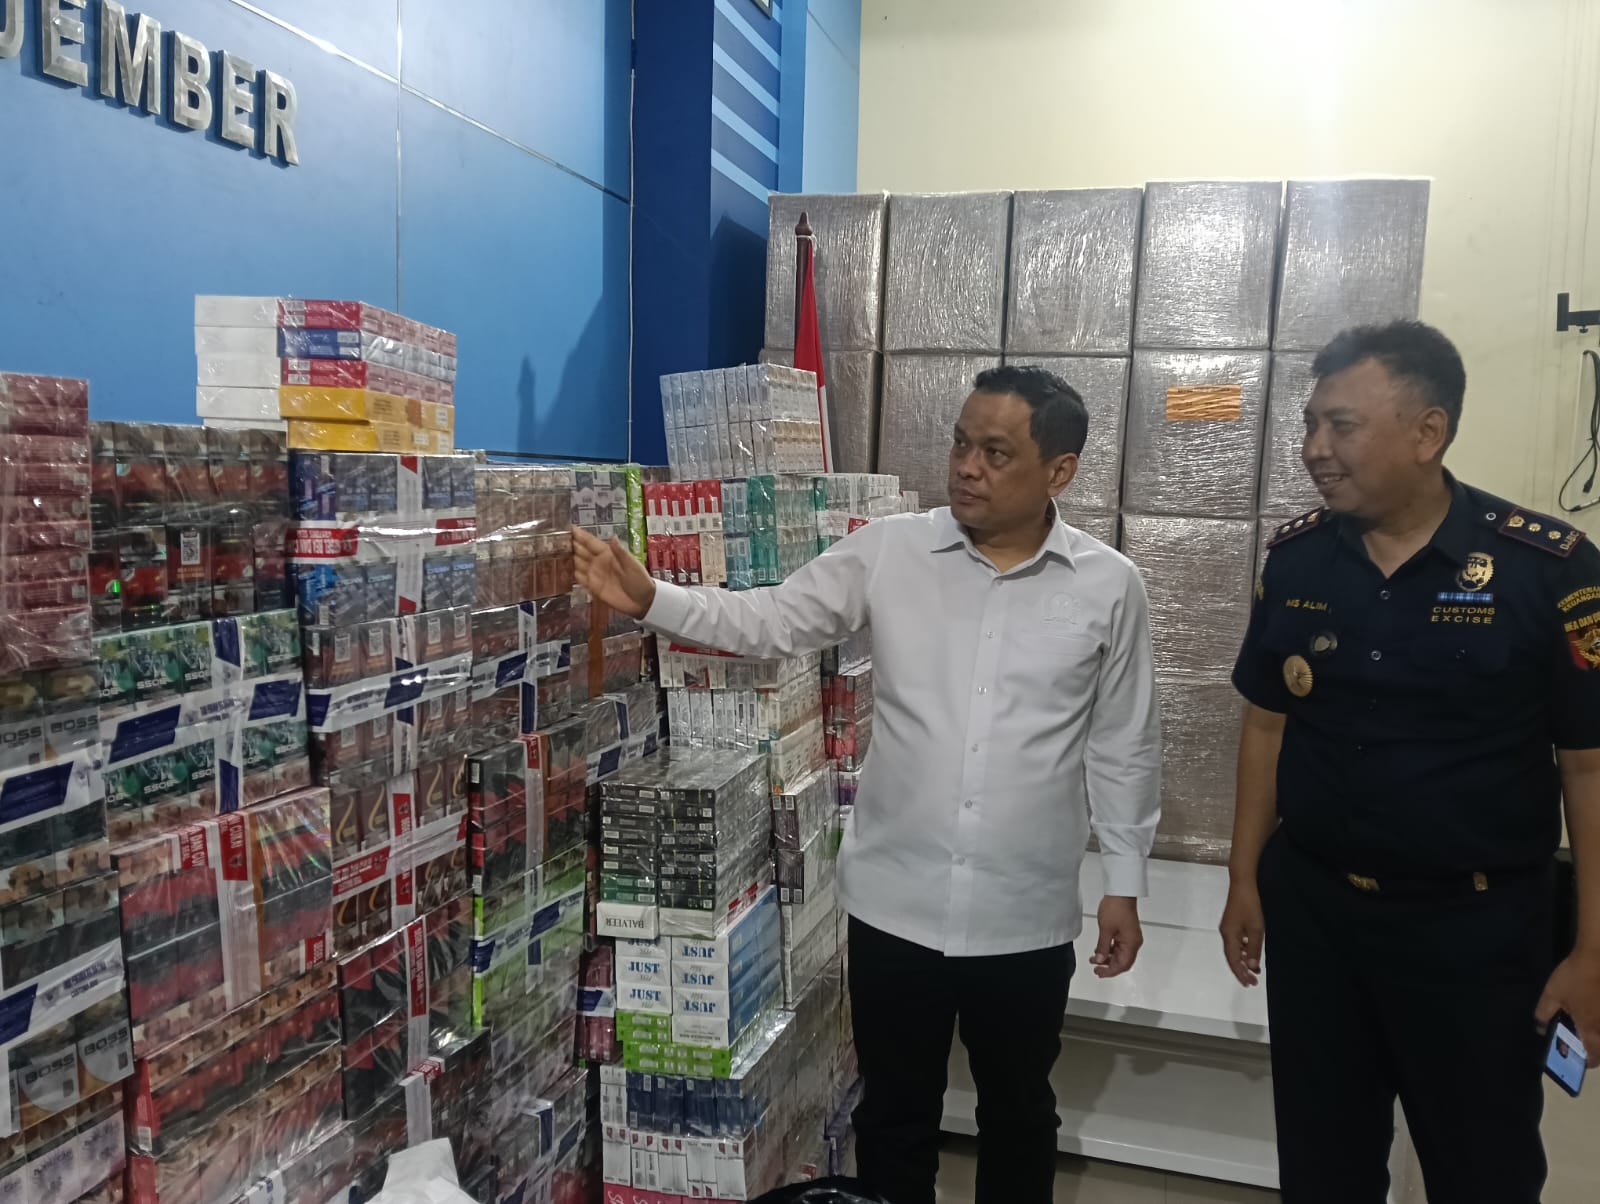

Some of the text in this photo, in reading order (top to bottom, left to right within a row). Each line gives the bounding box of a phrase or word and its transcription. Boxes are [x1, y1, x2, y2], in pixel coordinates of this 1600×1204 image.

[1557, 586, 1600, 609] KEMENTERIA
[1433, 606, 1496, 616] CUSTOMS
[1431, 615, 1494, 625] EXCISE
[50, 714, 98, 735] BOSS
[0, 726, 42, 745] OSS
[605, 917, 645, 929] BALVEER
[681, 945, 715, 959] JUST
[628, 961, 660, 975] JUST
[681, 972, 714, 986] JUST
[629, 988, 662, 1002] JUST
[683, 998, 716, 1014] JUST
[84, 1027, 129, 1056] BOSS
[25, 1053, 75, 1085] BOSS
